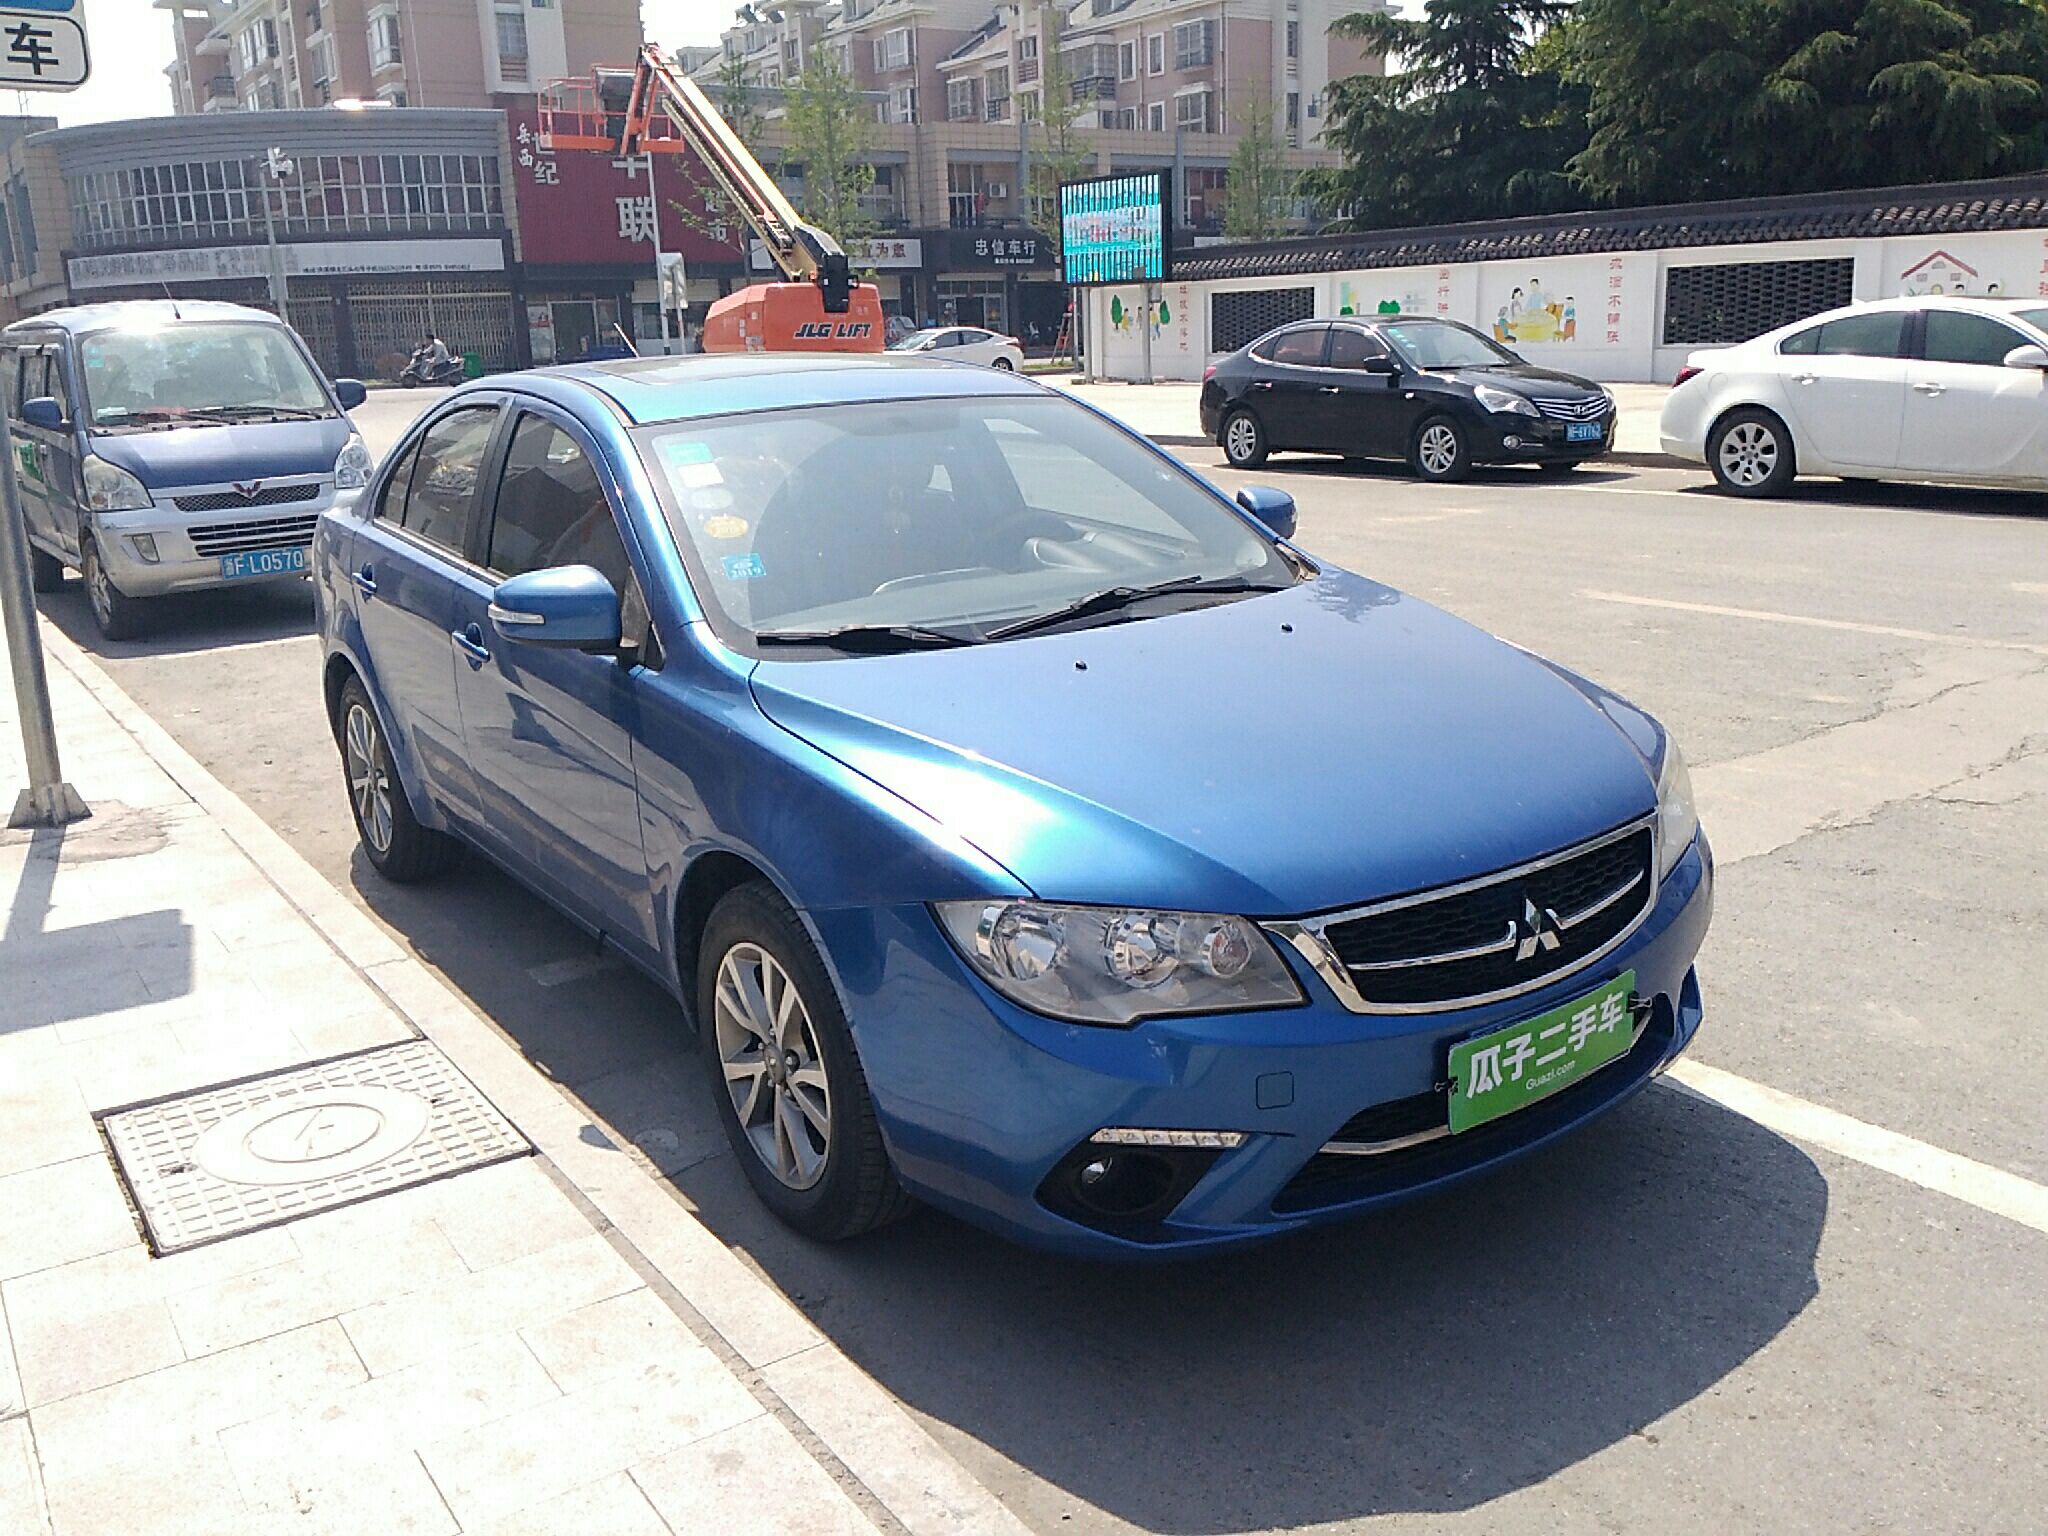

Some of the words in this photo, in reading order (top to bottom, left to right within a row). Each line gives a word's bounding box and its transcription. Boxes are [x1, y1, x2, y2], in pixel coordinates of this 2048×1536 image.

[4, 21, 59, 76] 车
[975, 239, 1036, 256] 忠信车行
[793, 322, 833, 340] JLG
[835, 322, 873, 339] LIFT
[1466, 990, 1625, 1100] 瓜子二手车
[1524, 1059, 1576, 1091] Guazi.com
